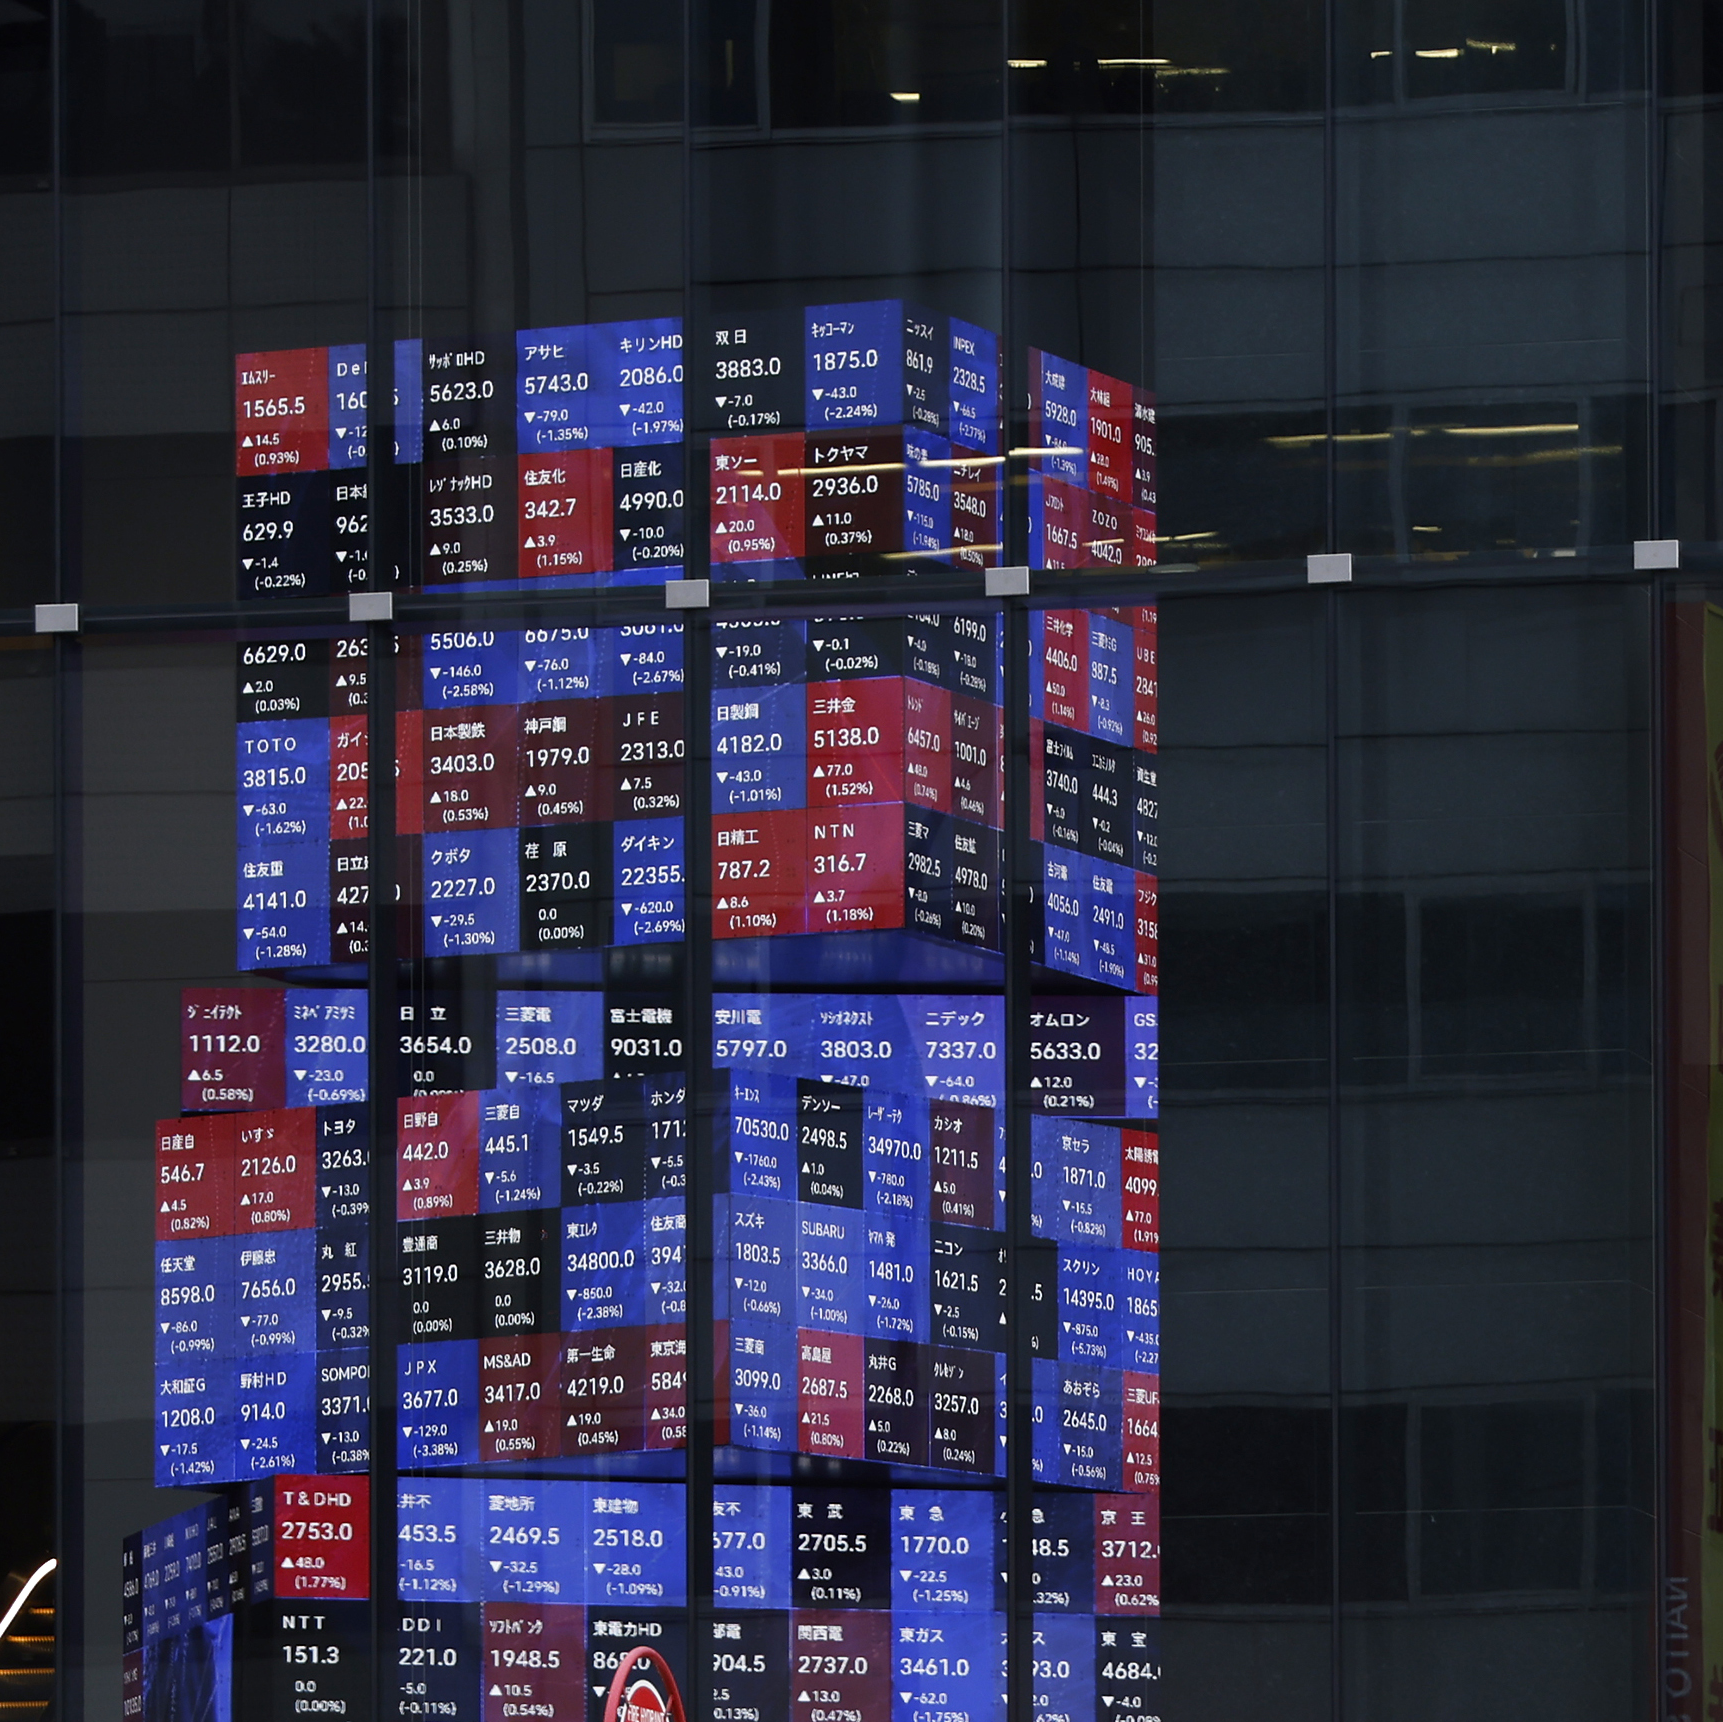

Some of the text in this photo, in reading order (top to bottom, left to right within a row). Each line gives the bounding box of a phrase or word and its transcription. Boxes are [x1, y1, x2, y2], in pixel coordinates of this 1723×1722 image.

[715, 356, 781, 380] 3883.0
[813, 348, 879, 371] 1875.0
[524, 372, 589, 395] 5743.0
[619, 364, 684, 387] 2086.0
[429, 380, 494, 403] 5623.0
[243, 396, 306, 419] 1565.5
[824, 403, 878, 422] (-2.24%)
[727, 410, 781, 429] (-0.17%)
[536, 426, 589, 445] (-1.35%)
[254, 449, 300, 468] (0.93%)
[715, 482, 782, 505] 2114.0
[812, 474, 879, 498] 2936.0
[430, 504, 495, 527] 3533.0
[524, 497, 577, 520] 342.7
[242, 520, 294, 542] 629.9
[825, 529, 873, 547] (0.37%)
[727, 536, 776, 555] (0.95%)
[536, 550, 583, 569] (1.15%)
[243, 643, 306, 665] 6629.0
[716, 733, 783, 755] 4182.0
[813, 726, 880, 749] 5138.0
[526, 746, 590, 768] 1979.0
[620, 739, 685, 762] 2313.0
[430, 752, 495, 775] 3403.0
[243, 766, 306, 788] 3815.0
[729, 786, 782, 805] (-1.01%)
[825, 780, 874, 798] (1.52%)
[442, 806, 489, 824] (0.53%)
[537, 799, 584, 817] (0.45%)
[255, 819, 307, 838] (-1.62%)
[717, 859, 771, 880] 787.2
[813, 852, 867, 874] 316.7
[430, 876, 496, 899] 2227.0
[526, 870, 590, 893] 2370.0
[243, 889, 307, 911] 4141.0
[729, 912, 777, 930] (1.10%)
[826, 906, 874, 924] (1.18%)
[443, 930, 495, 948] (-1.30%)
[538, 924, 584, 942] (0.00%)
[189, 1034, 260, 1053] 1112.0
[399, 1035, 472, 1054] 3654.0
[505, 1036, 577, 1056] 2508.0
[610, 1038, 683, 1057] 9031.0
[715, 1039, 787, 1058] 5797.0
[820, 1040, 892, 1059] 3803.0
[925, 1041, 997, 1060] 7337.0
[1030, 1042, 1101, 1060] 5633.0
[1042, 1094, 1095, 1109] (0.21%)
[484, 1133, 528, 1155] 445.1
[568, 1125, 624, 1147] 1549.5
[801, 1125, 848, 1150] 2498.5
[402, 1141, 449, 1162] 442.0
[934, 1145, 979, 1170] 1211.5
[160, 1162, 205, 1184] 546.7
[241, 1154, 296, 1177] 2126.0
[567, 1249, 635, 1272] 34800.0
[801, 1250, 848, 1275] 3366.0
[402, 1264, 458, 1286] 3119.0
[160, 1284, 215, 1306] 8598.0
[1063, 1287, 1115, 1311] 14395.0
[483, 1352, 531, 1370] MS&AD
[484, 1381, 541, 1404] 3417.0
[802, 1376, 848, 1399] 2687.5
[402, 1388, 458, 1410] 3677.0
[934, 1392, 979, 1415] 3257.0
[161, 1406, 215, 1428] 1208.0
[1063, 1409, 1107, 1432] 2645.0
[281, 1521, 353, 1541] 2753.0
[489, 1525, 560, 1545] 2469.5
[797, 1533, 867, 1553] 2705.5
[900, 1535, 970, 1555] 1770.0
[294, 1574, 347, 1591] (1.77%)
[282, 1645, 340, 1664] 151.3
[490, 1649, 560, 1669] 1948.5
[797, 1655, 868, 1675] 2737.0
[900, 1657, 970, 1677] 3461.0
